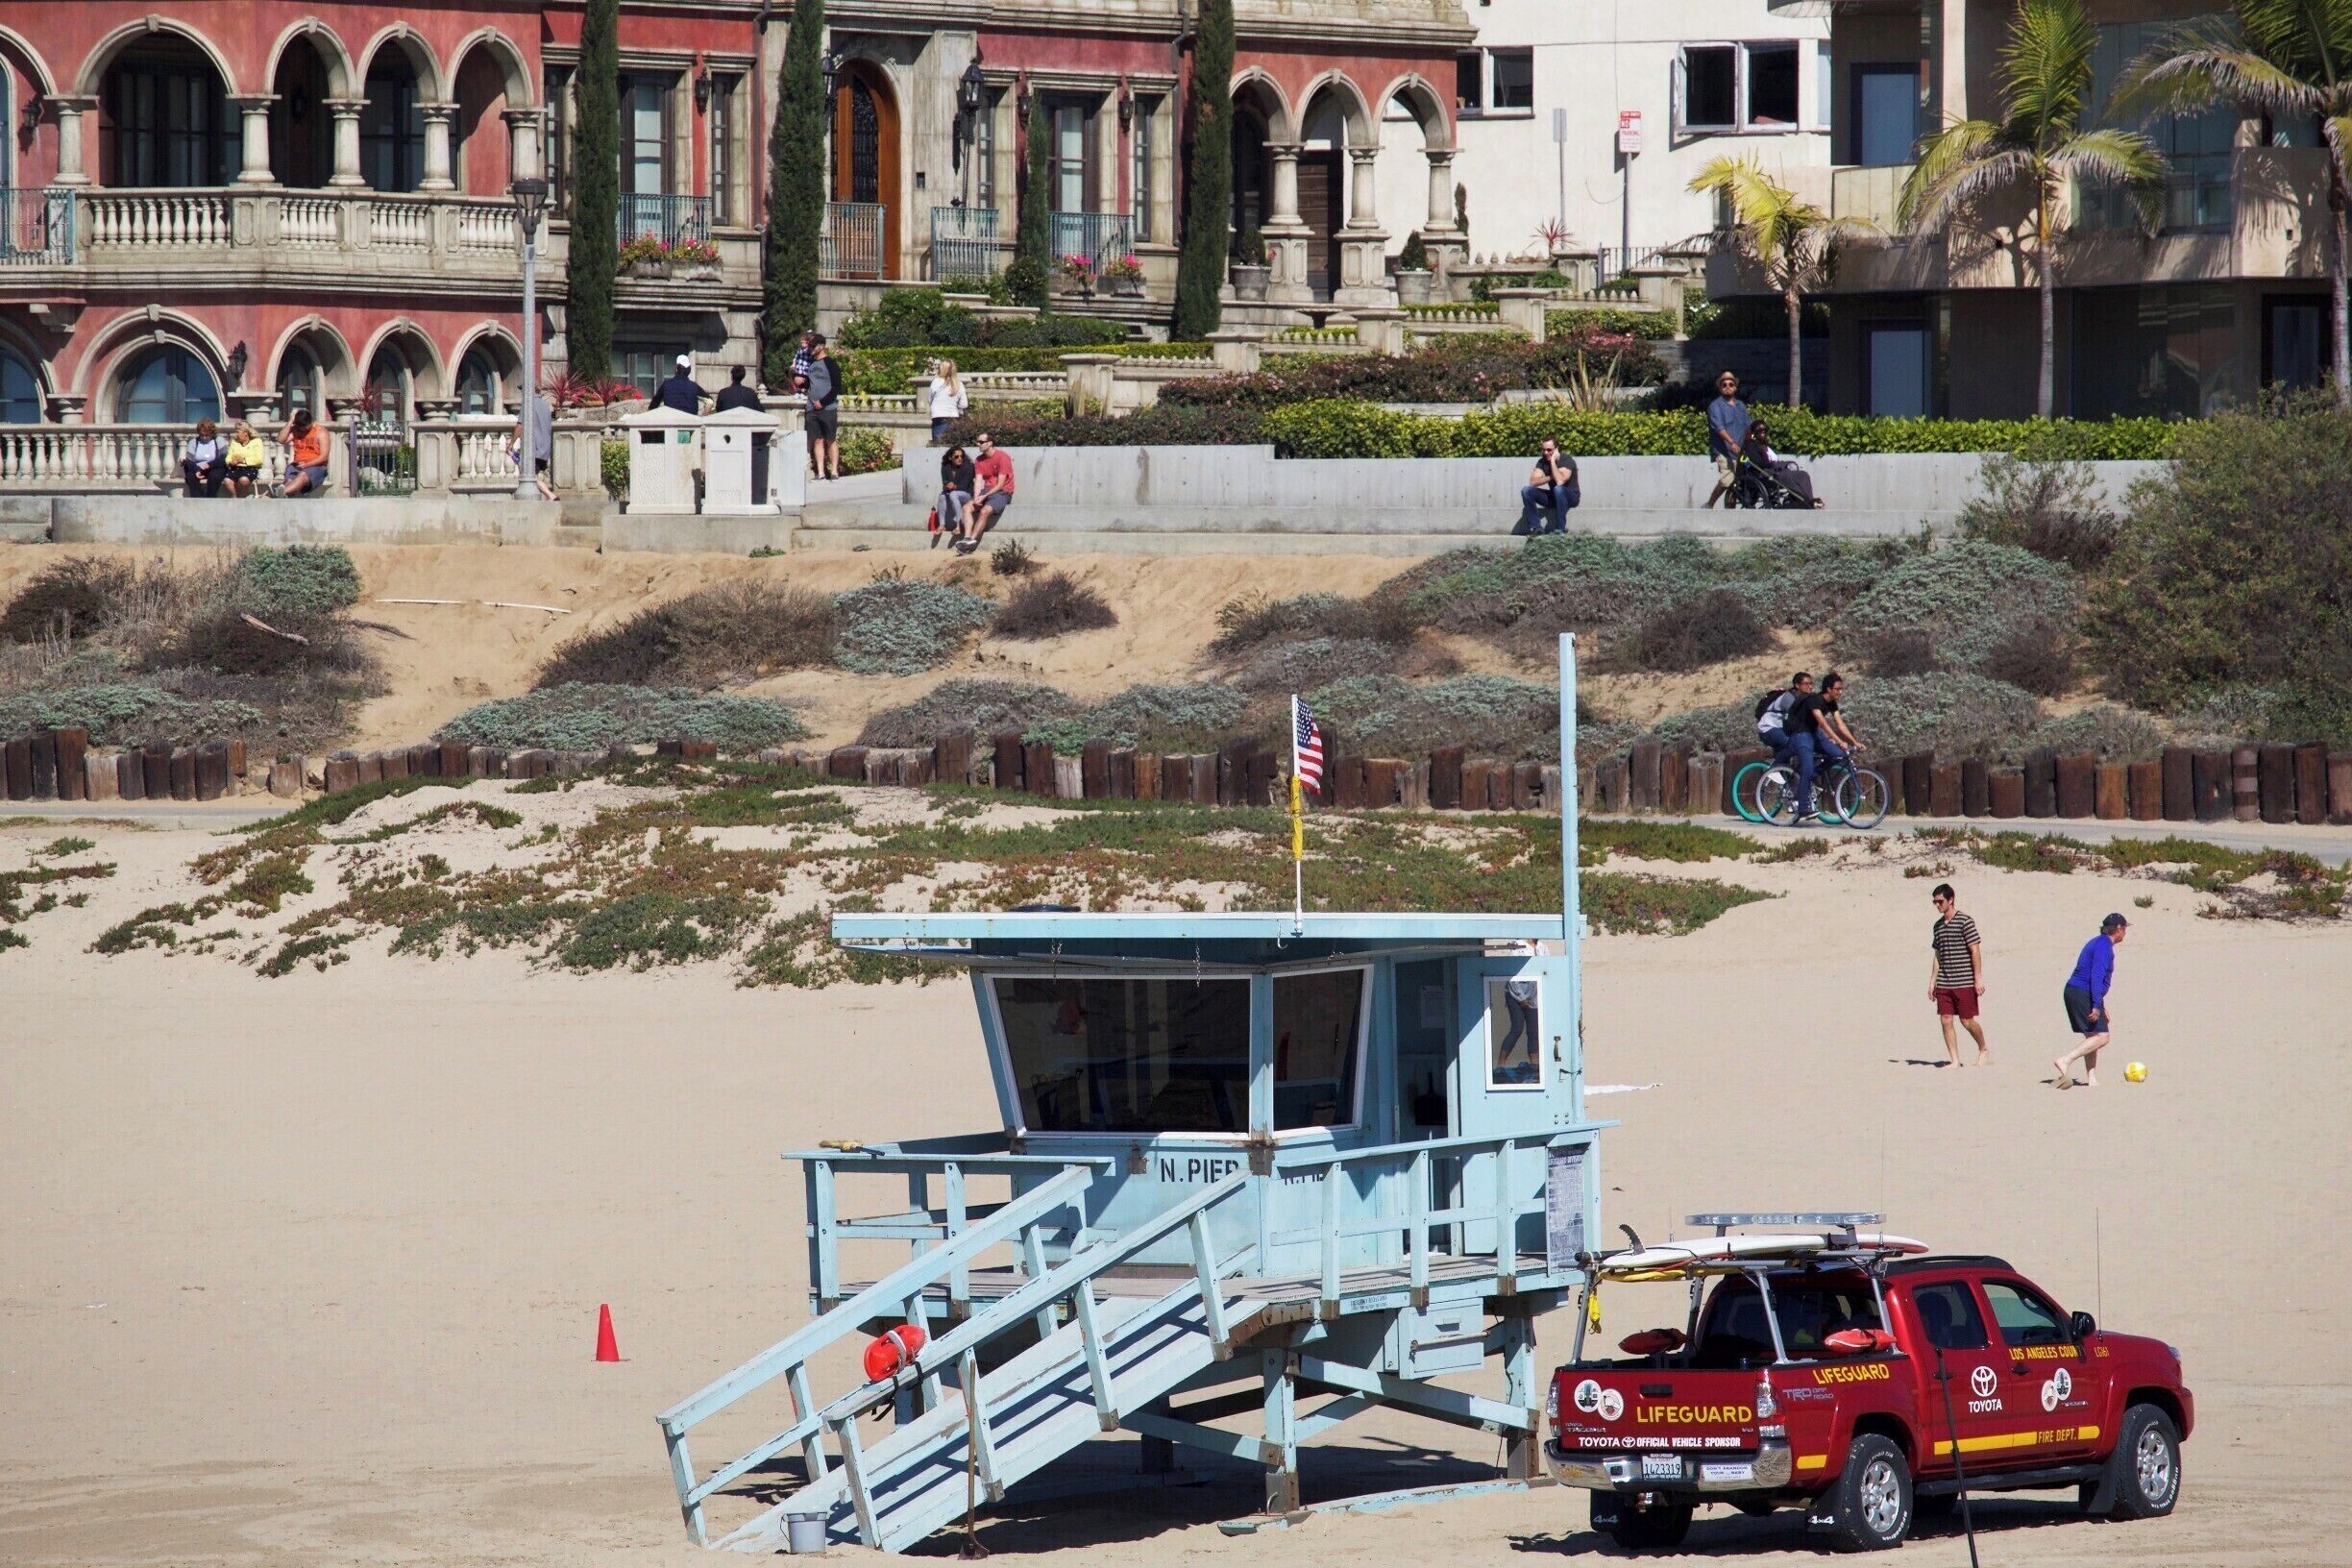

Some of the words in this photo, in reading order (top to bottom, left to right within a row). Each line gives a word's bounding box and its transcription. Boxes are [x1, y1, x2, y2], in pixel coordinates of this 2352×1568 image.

[2009, 1347, 2024, 1360] LOS
[2025, 1346, 2058, 1359] ANGELES
[2058, 1345, 2079, 1357] COUN
[1813, 1364, 1890, 1384] LIFEGUARD
[1782, 1387, 1812, 1401] TRD
[1969, 1399, 2002, 1412] TOYOTA
[1636, 1406, 1752, 1423] LIFEGUARD
[1579, 1437, 1620, 1447] TOYOTA
[1636, 1437, 1669, 1447] OFFICIAL
[1672, 1437, 1703, 1447] VEHICLE
[1704, 1437, 1741, 1447] SPONSOR
[2038, 1431, 2053, 1443] FIRE
[2056, 1428, 2077, 1441] DEPT.
